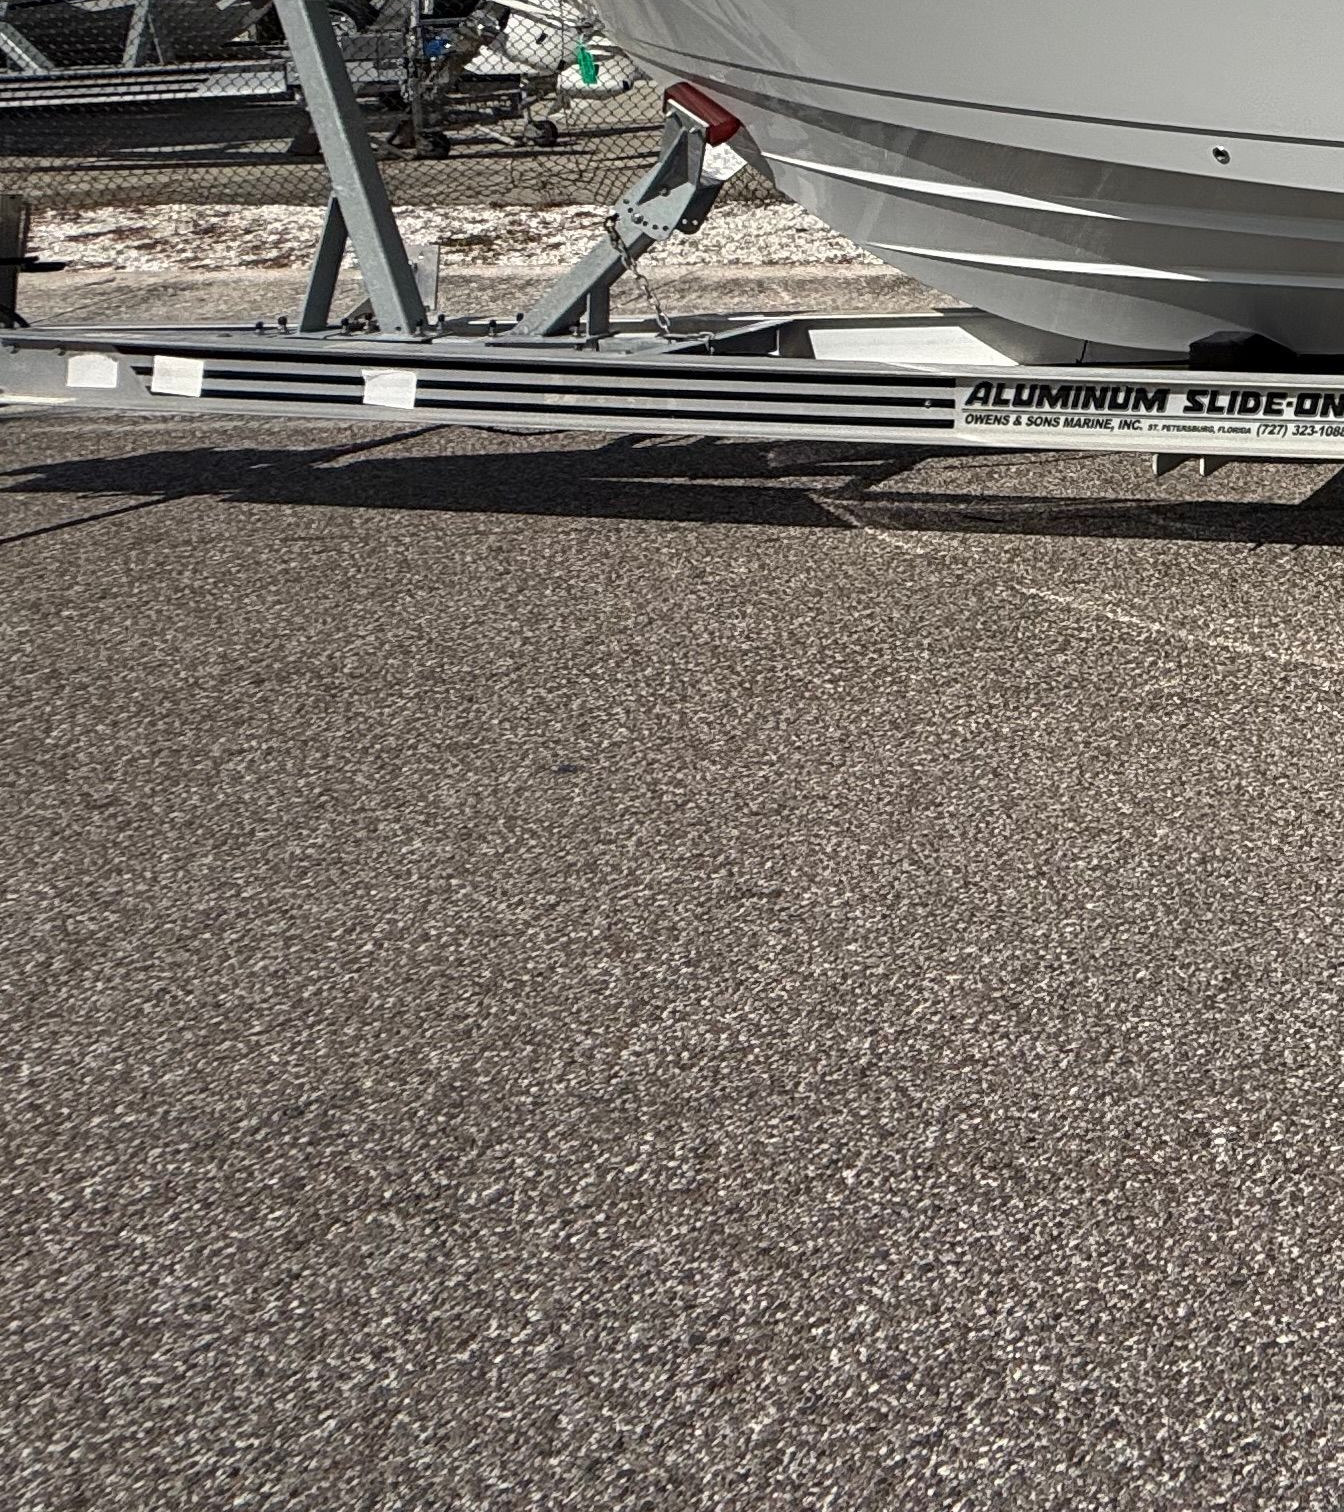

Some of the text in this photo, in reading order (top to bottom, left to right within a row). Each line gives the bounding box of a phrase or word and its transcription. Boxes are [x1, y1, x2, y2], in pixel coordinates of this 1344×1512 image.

[964, 380, 1170, 413] ALUMINUM
[965, 413, 1010, 426] OWENS
[1013, 417, 1023, 426] &
[1026, 416, 1060, 428] SONS
[1063, 417, 1115, 432] MARINE,
[1118, 419, 1143, 431] INC.
[1256, 424, 1288, 438] (727)
